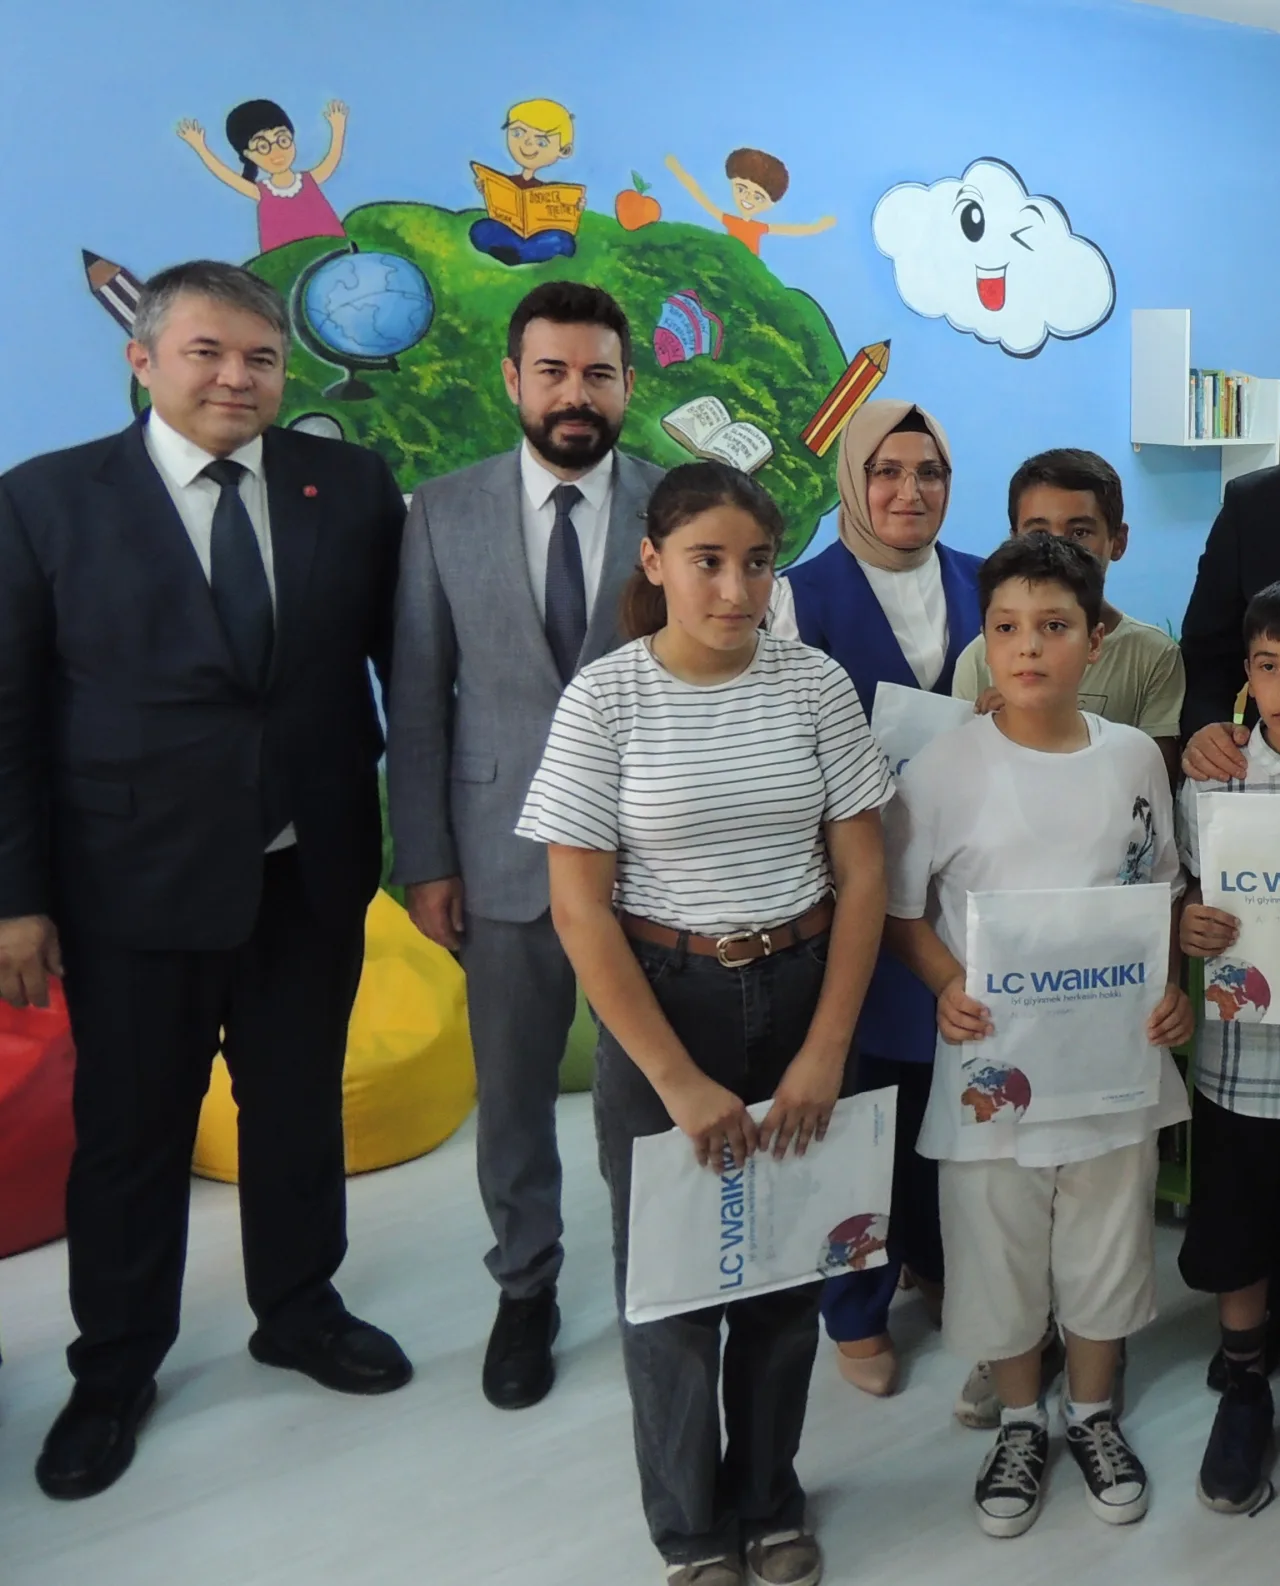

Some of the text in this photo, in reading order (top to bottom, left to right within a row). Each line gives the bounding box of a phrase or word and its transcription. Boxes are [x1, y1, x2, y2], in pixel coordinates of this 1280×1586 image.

[1220, 870, 1258, 893] LC
[986, 972, 1025, 994] LC
[719, 1252, 745, 1291] LC
